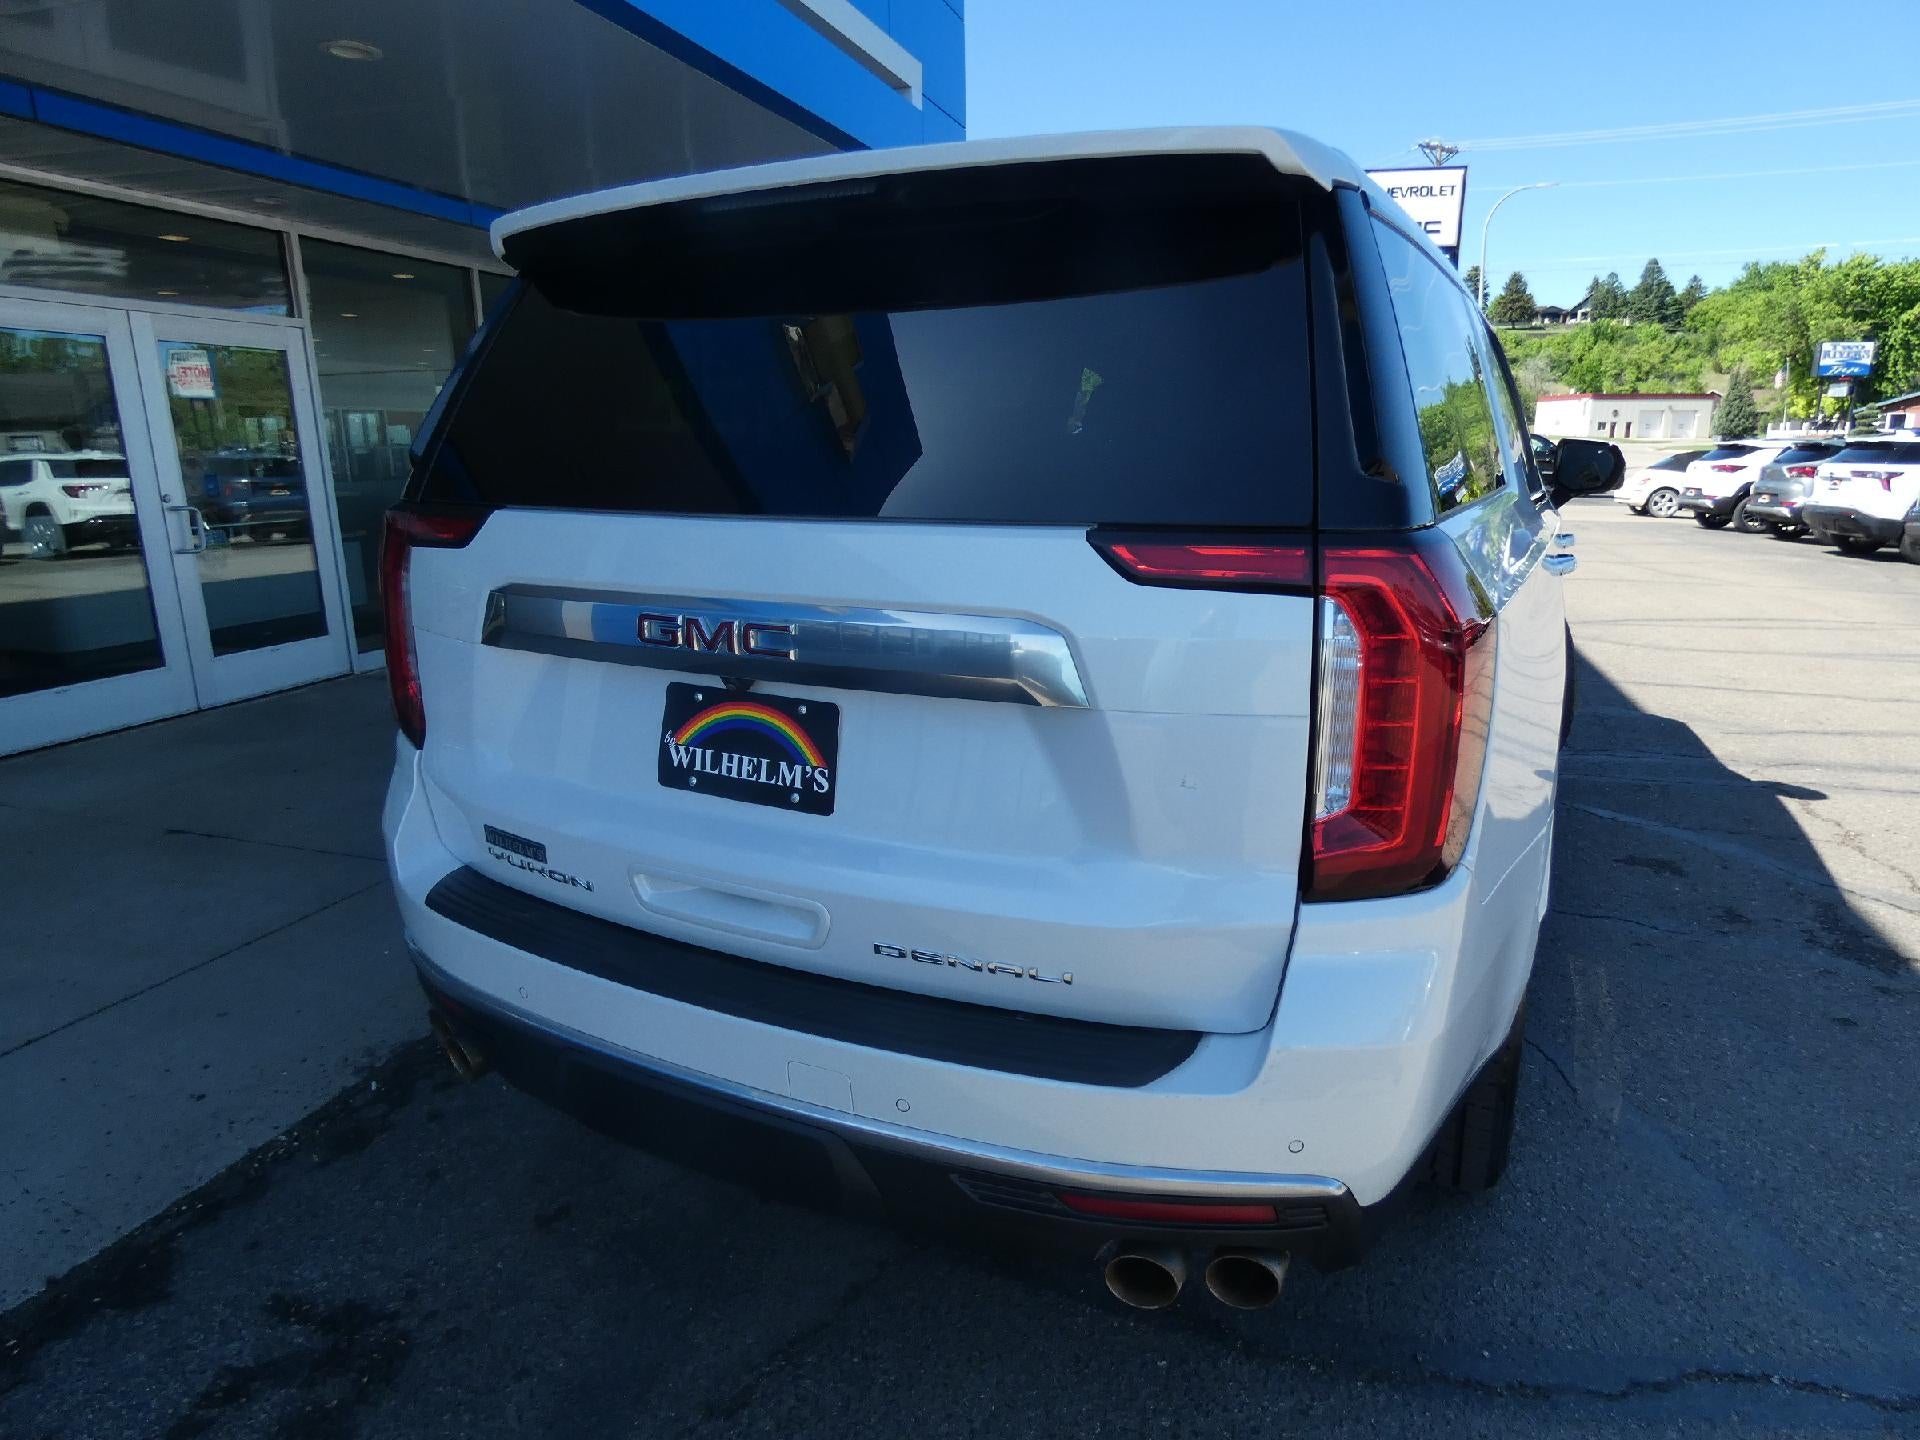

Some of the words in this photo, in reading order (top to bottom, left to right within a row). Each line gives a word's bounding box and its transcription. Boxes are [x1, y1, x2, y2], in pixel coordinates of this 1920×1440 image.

[1387, 185, 1456, 198] EVROLET
[637, 613, 799, 660] GMC
[669, 744, 830, 794] WILHELM'S
[488, 846, 595, 892] YUKON
[873, 942, 1073, 985] DENALI
